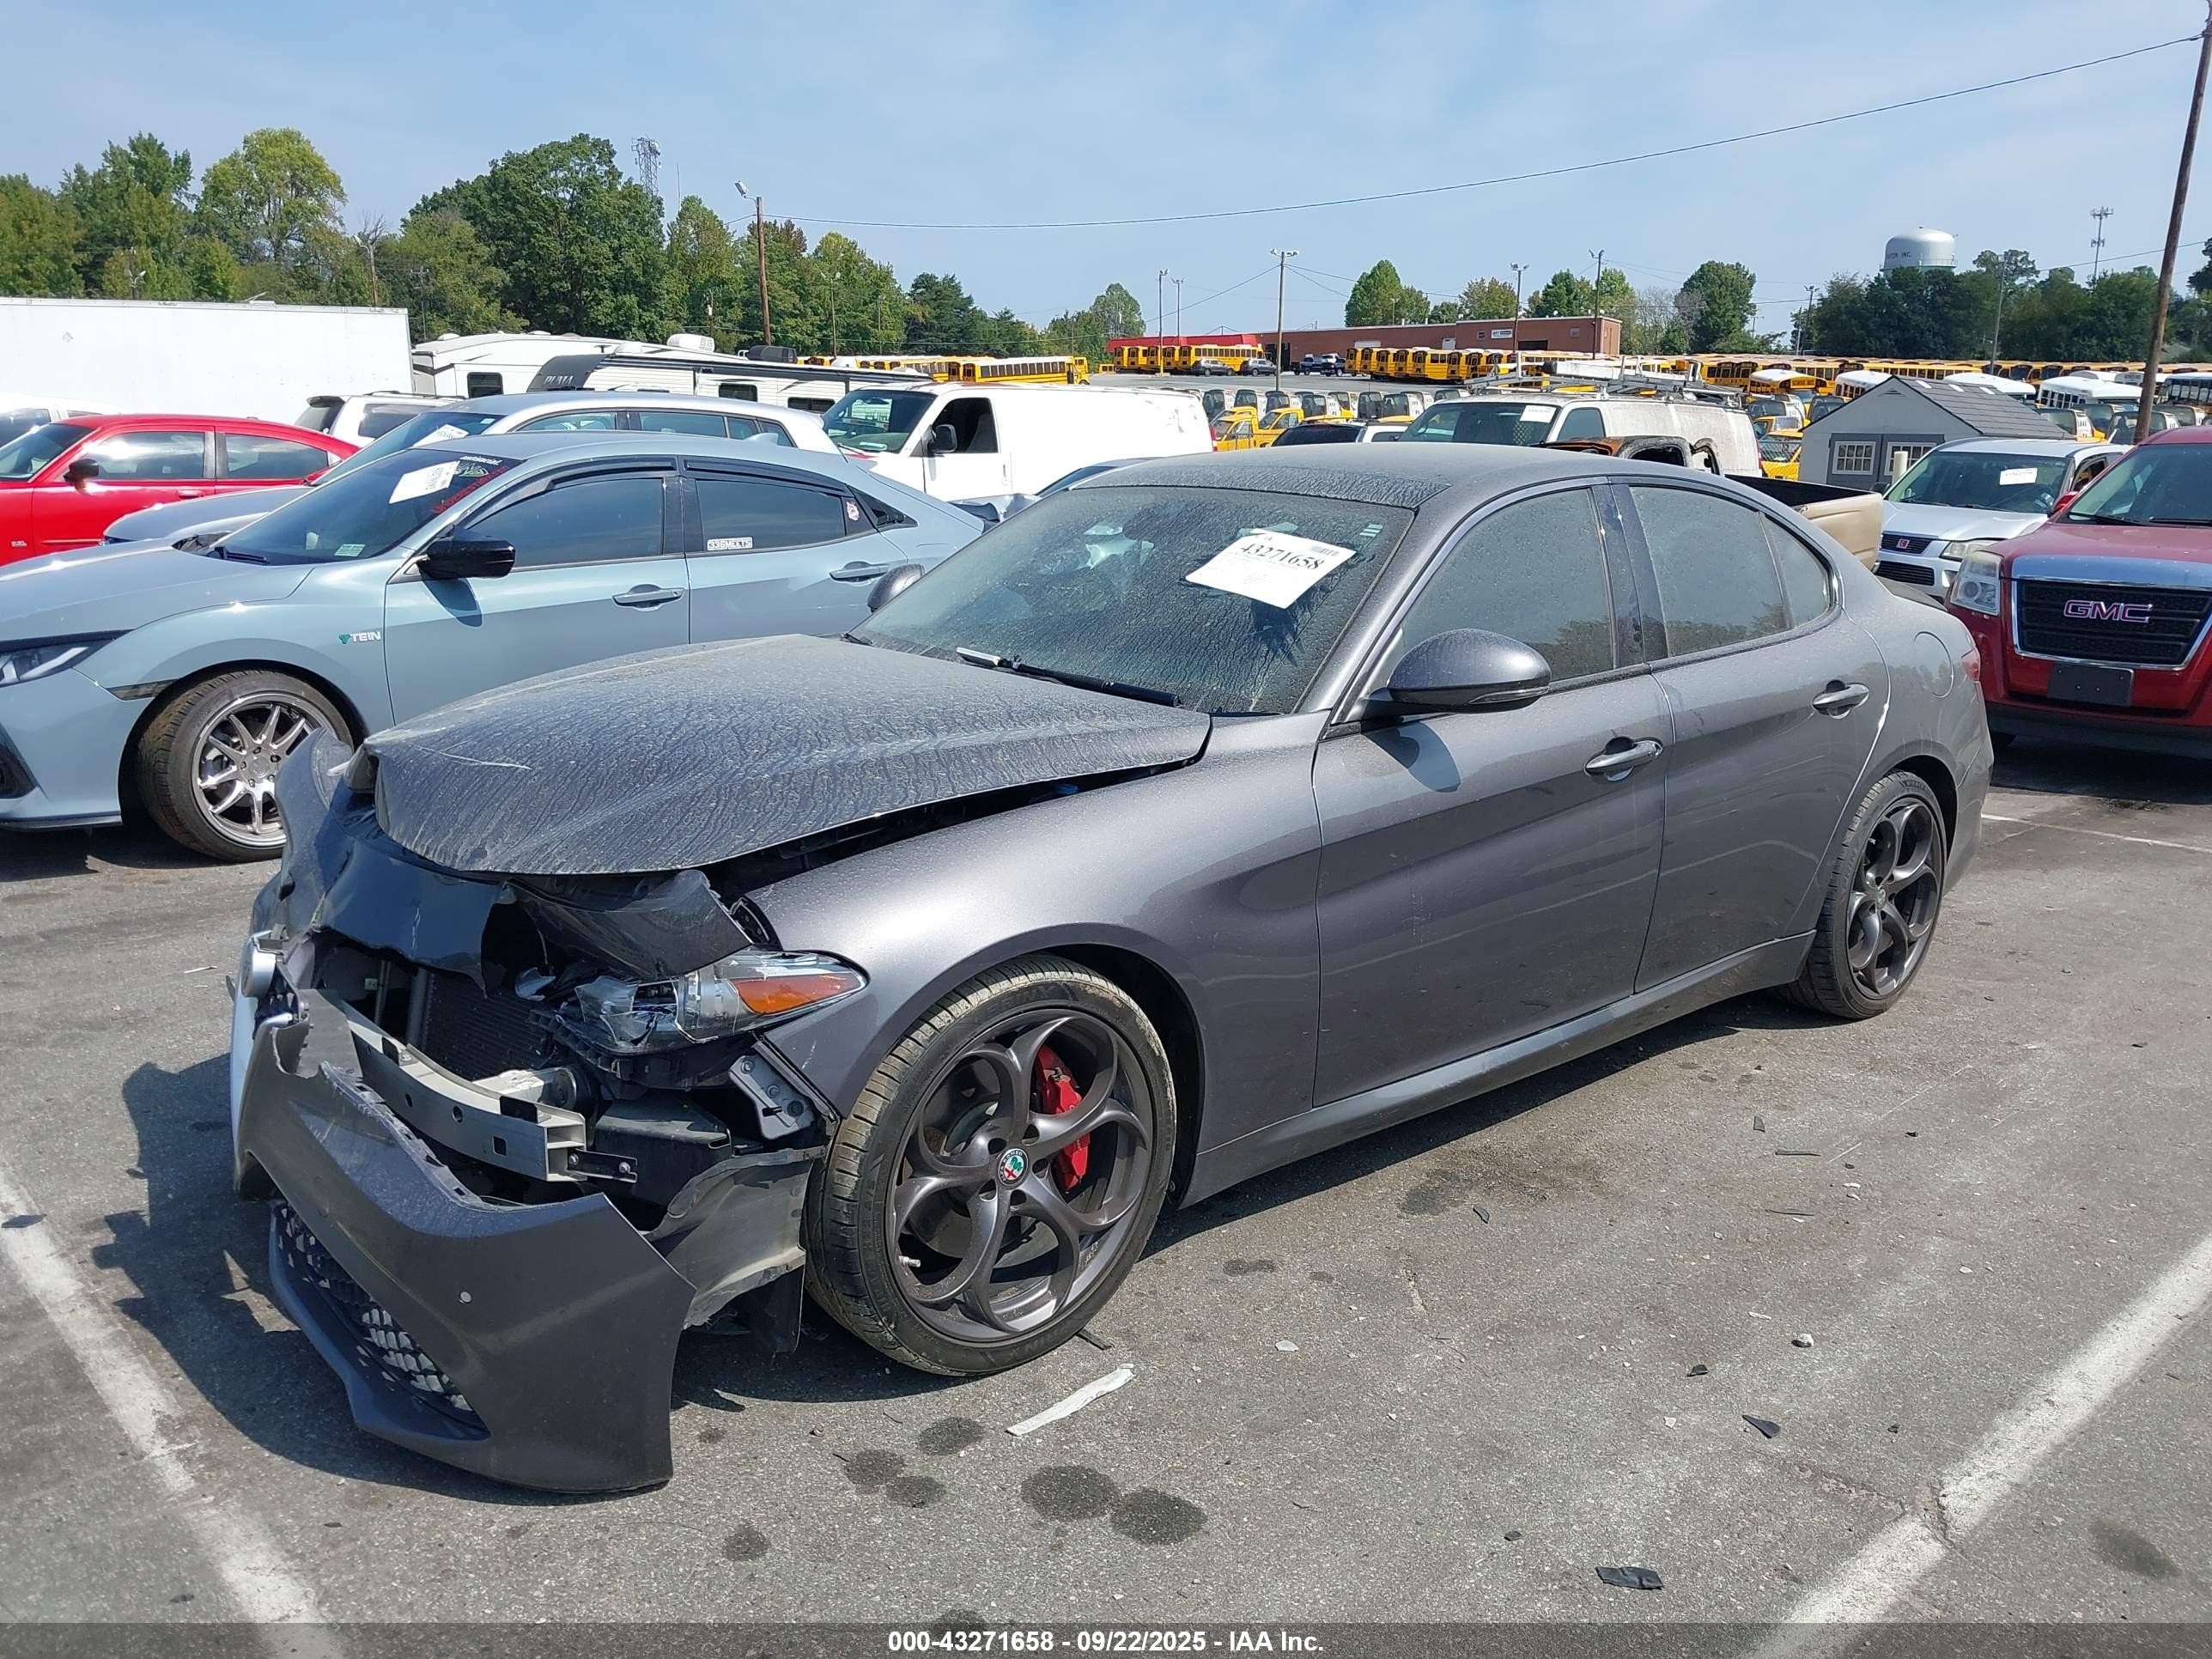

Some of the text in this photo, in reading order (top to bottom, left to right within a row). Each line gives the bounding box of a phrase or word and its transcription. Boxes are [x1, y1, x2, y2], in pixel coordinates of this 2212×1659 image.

[543, 375, 574, 386] PUMA
[1240, 544, 1325, 569] 43271658
[2063, 599, 2154, 623] GMC
[350, 631, 381, 643] TEIN
